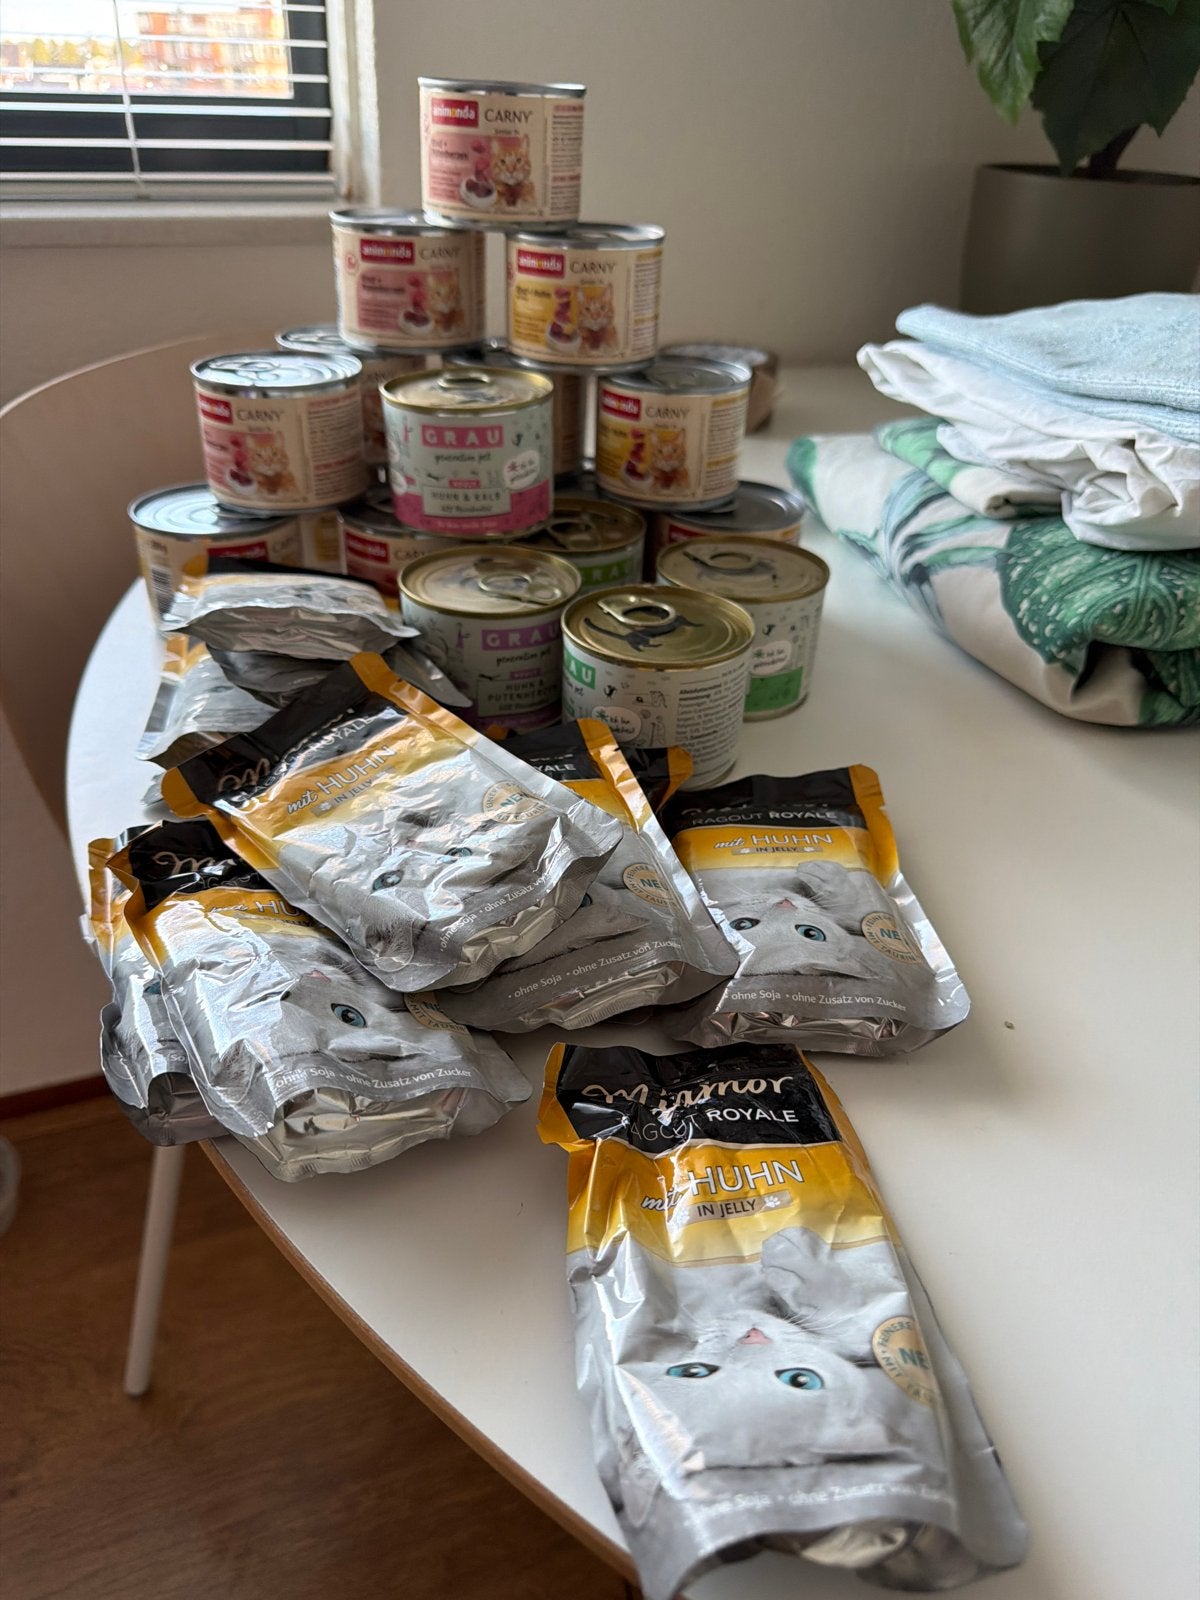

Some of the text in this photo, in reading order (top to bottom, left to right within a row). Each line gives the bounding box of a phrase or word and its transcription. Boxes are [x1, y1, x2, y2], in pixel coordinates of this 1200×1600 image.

[484, 108, 532, 123] CARNY
[570, 261, 616, 275] CARNY
[645, 406, 689, 419] CARNY
[424, 429, 500, 446] GRAU
[486, 624, 560, 648] GRAU
[287, 789, 318, 815] mit
[316, 745, 397, 795] HUHN
[333, 777, 374, 804] IN JELLY
[692, 811, 838, 826] RAGOUT ROYALE
[714, 833, 833, 849] mit HUHN
[484, 897, 507, 913] ohne
[507, 884, 535, 902] Zusatz
[256, 899, 304, 917] HU
[514, 983, 539, 999] ohne
[540, 973, 563, 989] Soja
[572, 963, 598, 977] ohne
[599, 951, 632, 968] Zusatz
[731, 991, 758, 1001] ohne
[759, 989, 781, 1001] Soja
[791, 992, 816, 1004] ohne
[818, 994, 852, 1005] Zusatz
[855, 995, 874, 1004] von
[311, 1068, 336, 1079] Soja
[372, 1078, 412, 1089] Zusatz
[413, 1073, 435, 1083] von
[437, 1068, 472, 1078] Zucker
[705, 1107, 800, 1124] ROYALE
[686, 1158, 804, 1197] HUHN
[696, 1198, 756, 1218] IN JELLY
